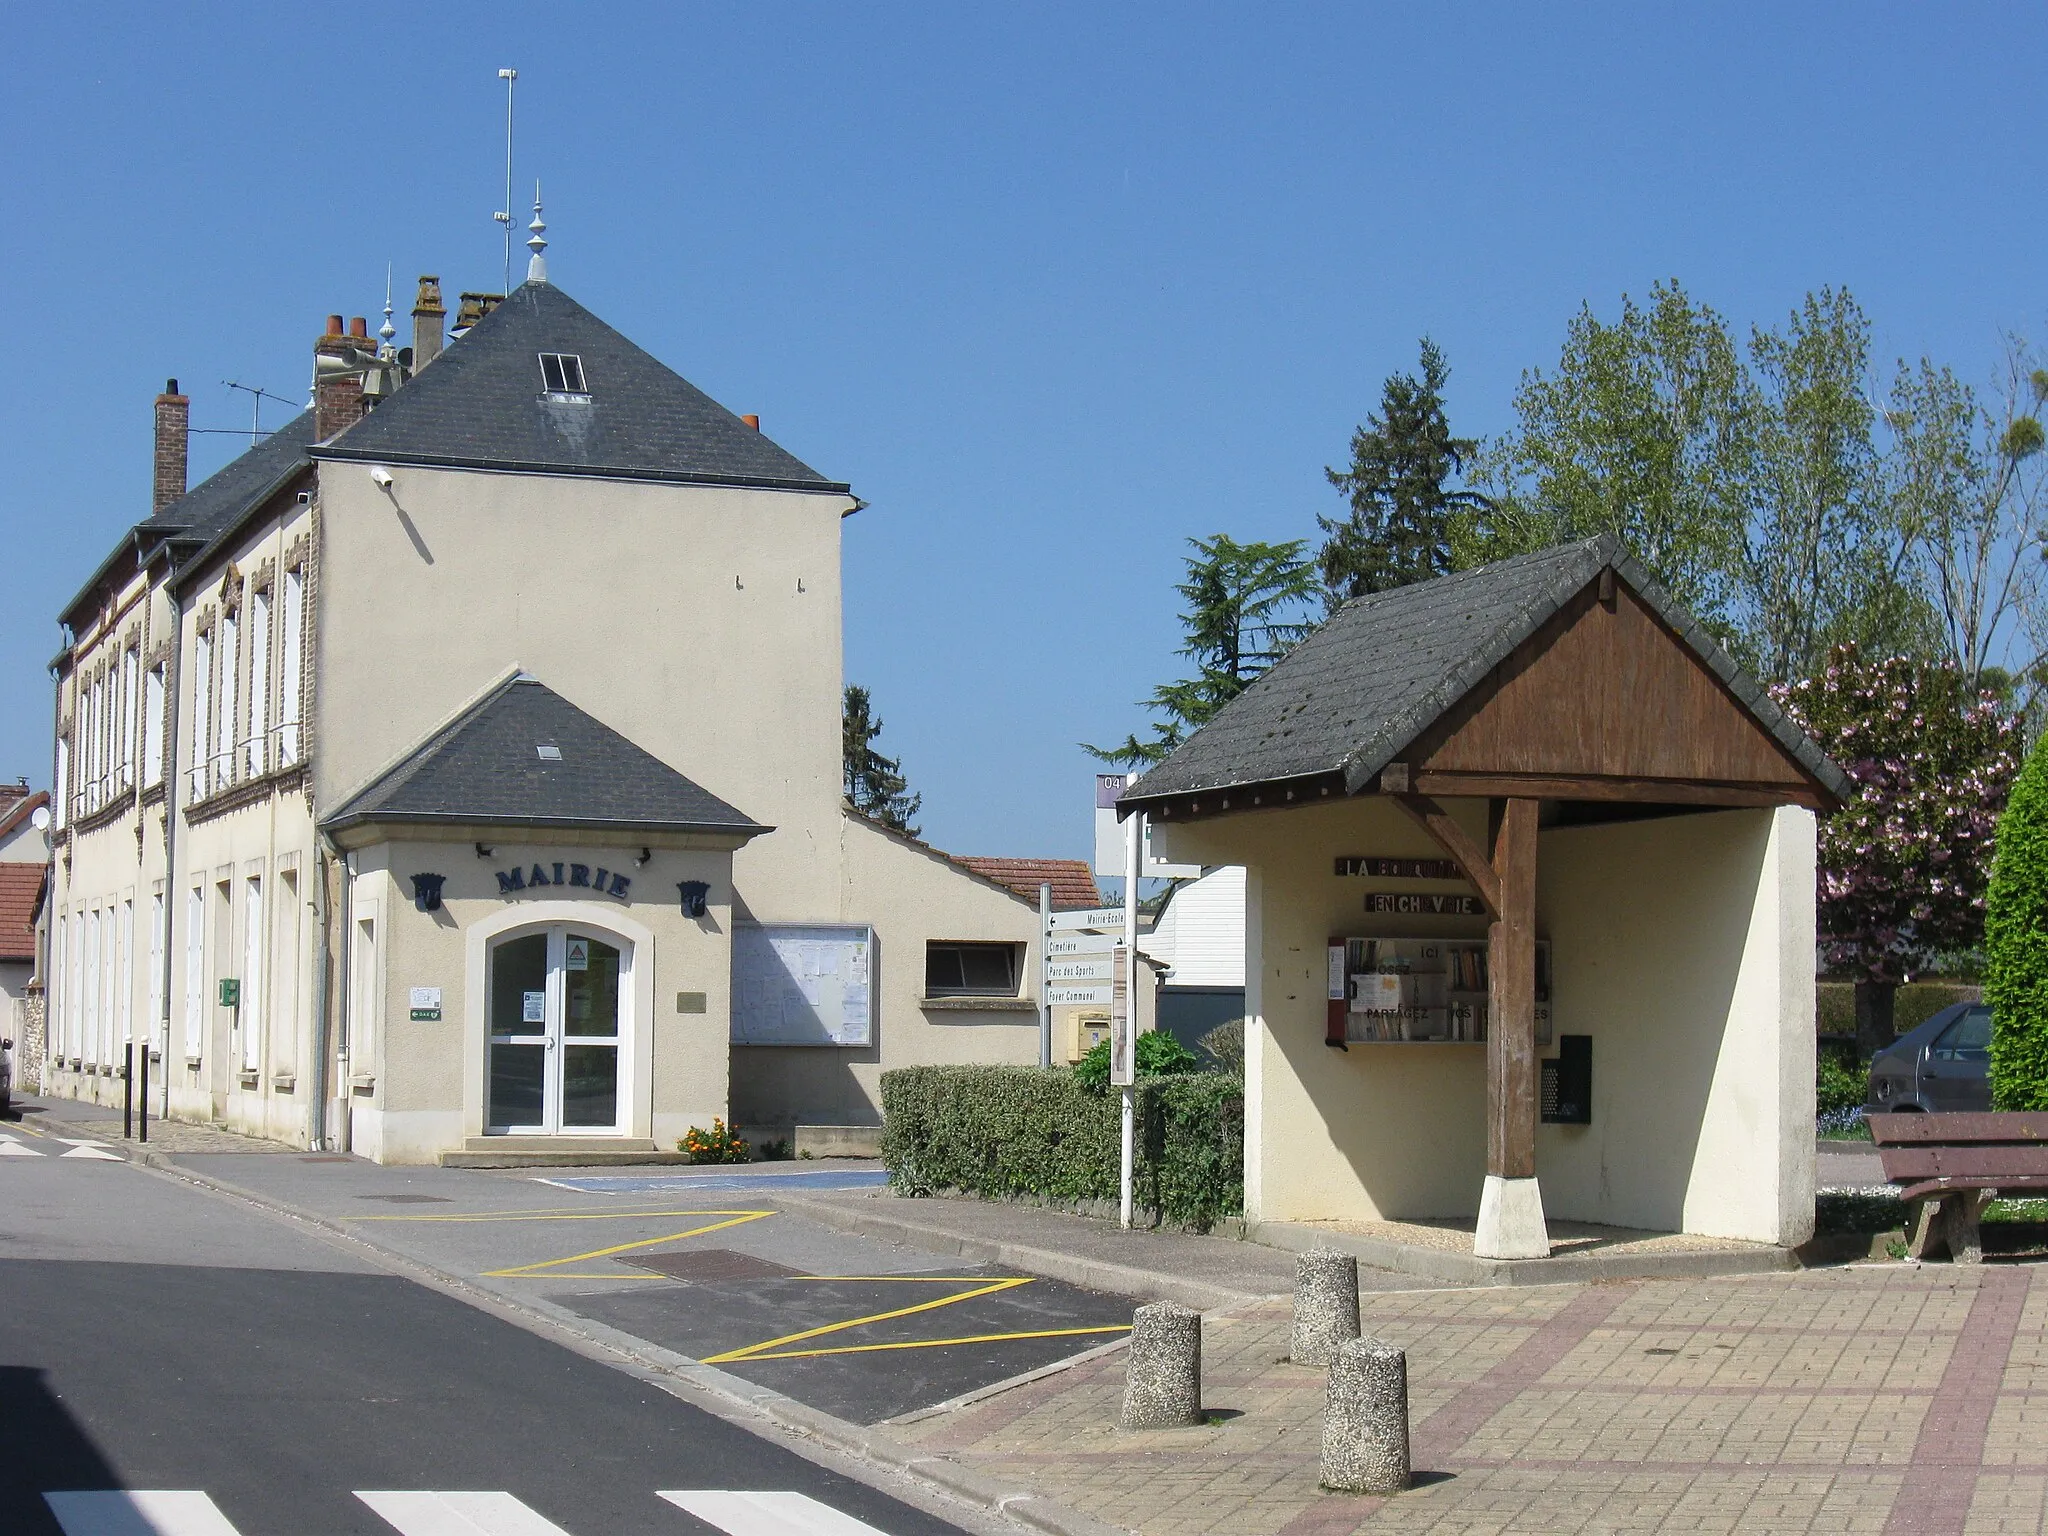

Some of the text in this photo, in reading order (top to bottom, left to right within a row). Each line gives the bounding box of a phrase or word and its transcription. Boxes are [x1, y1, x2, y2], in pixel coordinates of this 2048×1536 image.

[1104, 777, 1121, 789] 04
[1346, 859, 1369, 877] LA
[495, 862, 631, 899] MAIRIE
[1049, 941, 1076, 952] Cimetière
[1049, 965, 1094, 977] Parc des Sports
[1049, 990, 1095, 1003] Foyer Communal
